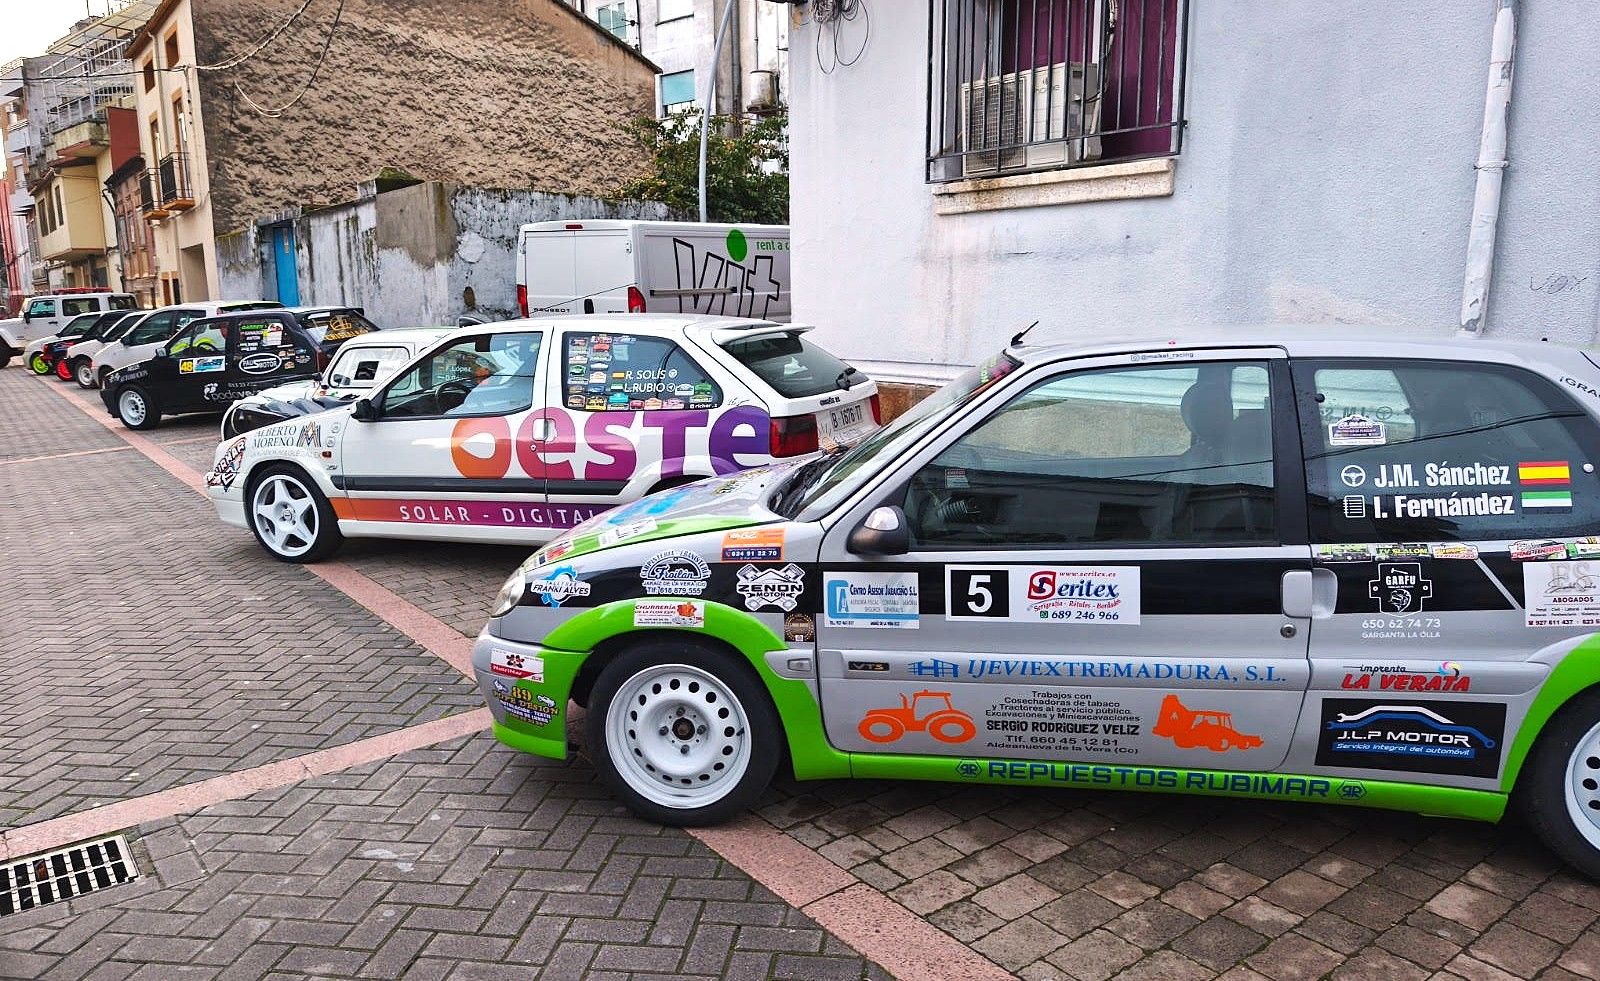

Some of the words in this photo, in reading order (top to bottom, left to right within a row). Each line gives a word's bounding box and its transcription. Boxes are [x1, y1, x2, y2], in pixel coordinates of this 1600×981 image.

[756, 240, 775, 250] rent
[181, 361, 193, 372] 48
[1374, 464, 1420, 488] J.M.
[1425, 461, 1511, 487] Sánchez
[1373, 496, 1388, 519] I.
[1394, 491, 1515, 518] Fernández
[399, 505, 471, 521] SOLAR
[655, 565, 693, 579] Froilán
[1385, 575, 1416, 585] GARFU
[563, 586, 590, 595] ALVES
[738, 584, 803, 592] ZENON
[967, 575, 993, 613] 5
[1051, 611, 1072, 619] 689
[1075, 611, 1096, 620] 246
[1098, 611, 1120, 620] 966
[1361, 619, 1385, 629] 650
[1388, 619, 1404, 629] 62
[1407, 618, 1422, 628] 74
[1424, 618, 1441, 628] 73
[1246, 665, 1287, 682] S.L.
[1360, 664, 1407, 677] imprenta
[1342, 674, 1370, 689] LA
[1379, 674, 1471, 692] VERATA
[1032, 690, 1071, 700] Trabajos
[1004, 697, 1071, 706] Cosechadoras
[999, 703, 1043, 712] Tractores
[1056, 706, 1094, 714] servicio
[985, 710, 1048, 718] Excavaciones
[1057, 712, 1141, 722] Miniexcavaciones
[1337, 731, 1381, 740] J.L.P
[987, 742, 1052, 750] Aldeanueva
[1373, 744, 1407, 752] integral
[1425, 748, 1470, 757] automóvil
[988, 762, 1177, 787] REPUESTOS
[1186, 771, 1330, 797] RUBIMAR
